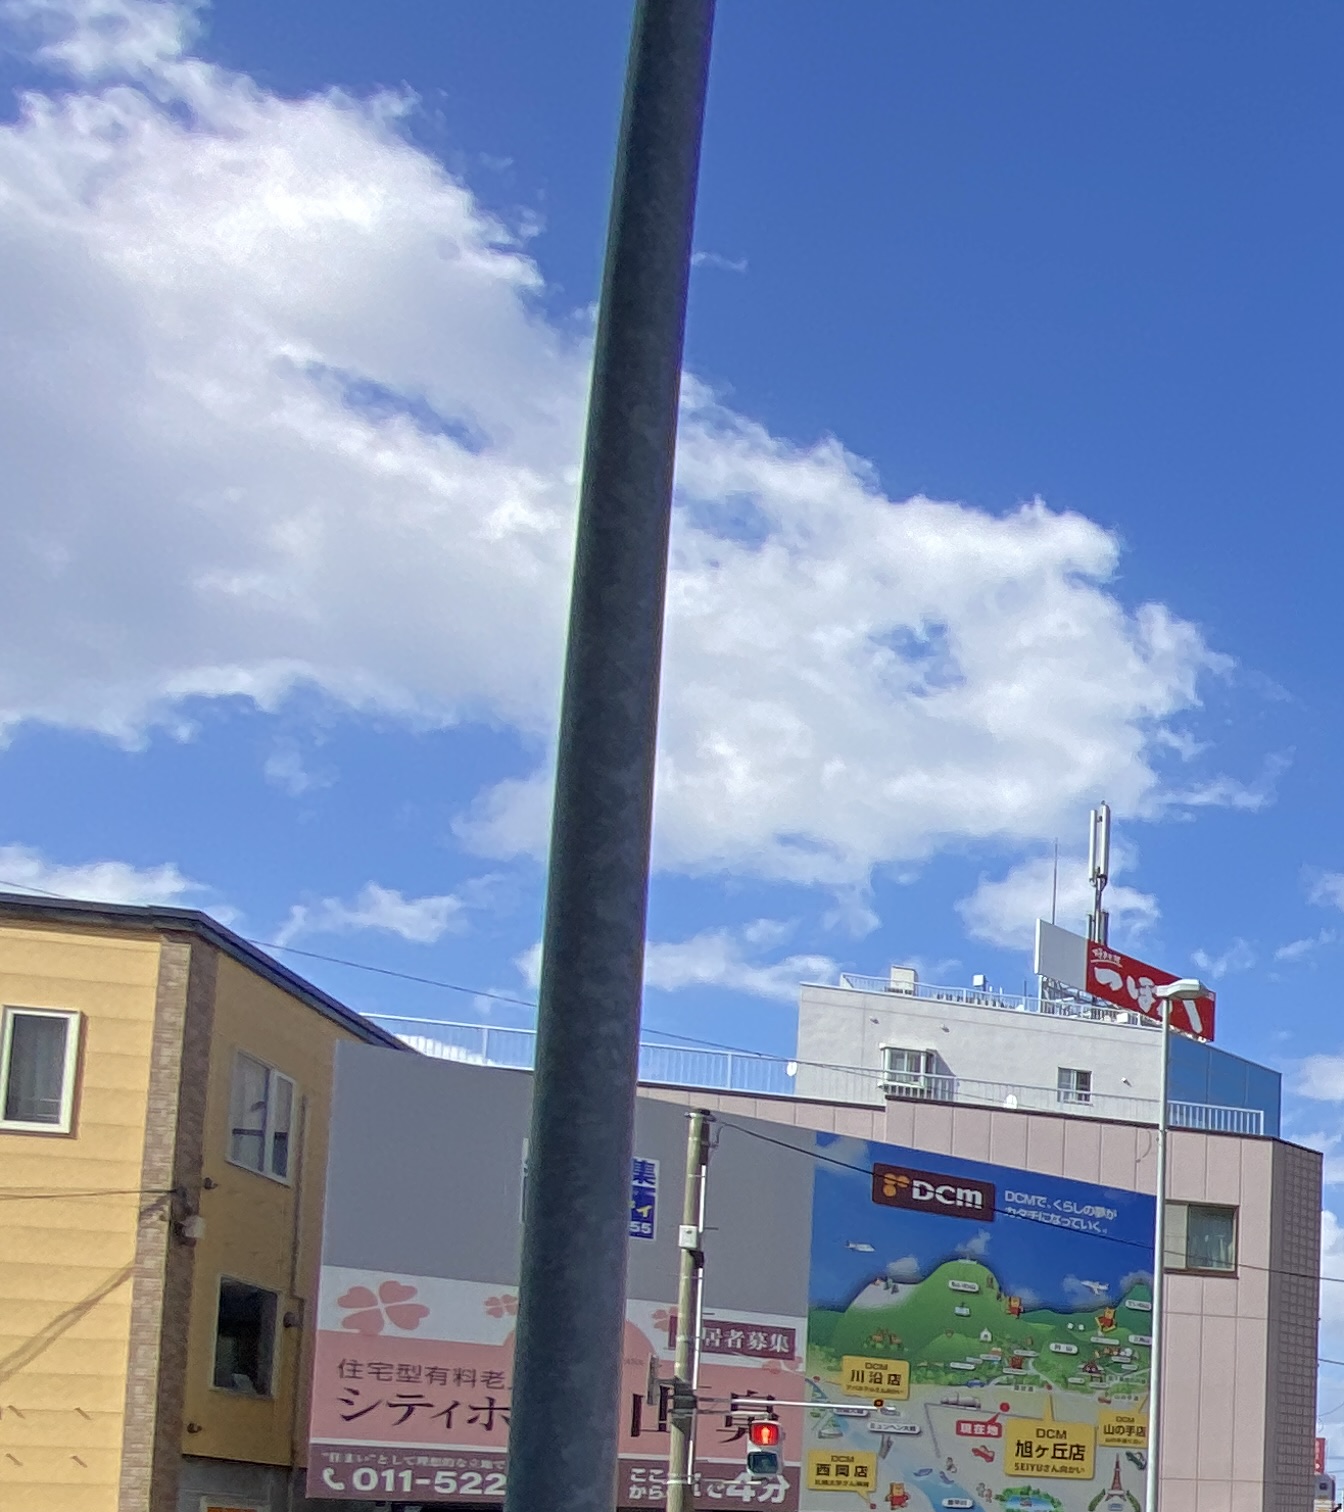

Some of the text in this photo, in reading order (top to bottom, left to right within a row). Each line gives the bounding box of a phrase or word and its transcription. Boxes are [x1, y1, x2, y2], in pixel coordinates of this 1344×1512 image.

[702, 1327, 789, 1353] 居者募集
[337, 1358, 512, 1390] 住宅型有料老
[850, 1369, 902, 1386] 川沿店
[960, 1422, 999, 1436] 現在地
[1035, 1428, 1067, 1439] DCM
[1103, 1423, 1147, 1438] 山の手店
[352, 1467, 508, 1496] 011-522
